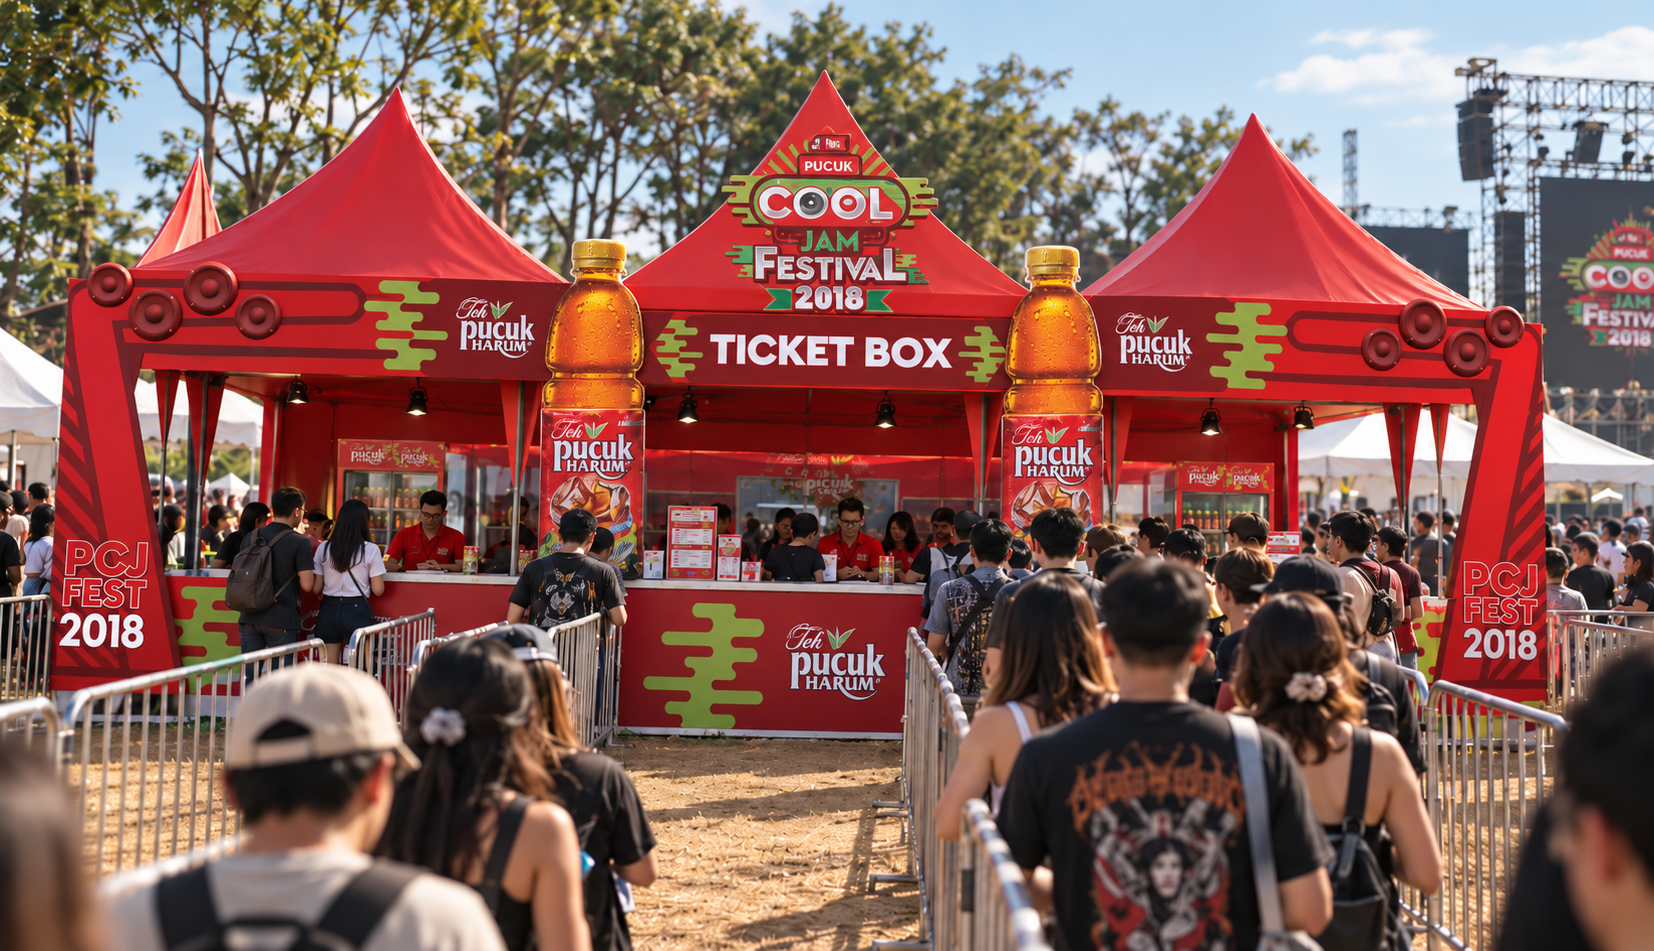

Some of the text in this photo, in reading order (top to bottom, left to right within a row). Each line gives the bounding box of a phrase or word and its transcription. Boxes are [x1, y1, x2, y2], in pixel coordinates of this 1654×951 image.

[804, 160, 853, 172] PUCUK
[759, 186, 893, 220] COOL
[800, 230, 859, 252] JAM
[755, 246, 907, 281] FESTIVAL
[1585, 264, 1654, 289] COO
[456, 297, 488, 319] Teh
[794, 285, 864, 310] 2018
[1611, 293, 1651, 309] JAM
[1582, 302, 1654, 328] FESTIV
[459, 315, 535, 350] pucuk
[1120, 329, 1193, 364] pucuk
[1607, 328, 1652, 347] 2018
[710, 334, 952, 368] TICKET BOX
[551, 418, 583, 439] Teh
[553, 433, 634, 472] pucuk
[1014, 439, 1094, 478] pucuk
[64, 540, 149, 578] PCJ
[62, 577, 148, 609] FEST
[1463, 561, 1538, 598] PCJ
[1463, 596, 1538, 625] FEST
[59, 612, 144, 649] 2018
[785, 623, 824, 650] Teh
[1463, 628, 1537, 660] 2018
[790, 643, 886, 689] pucuk
